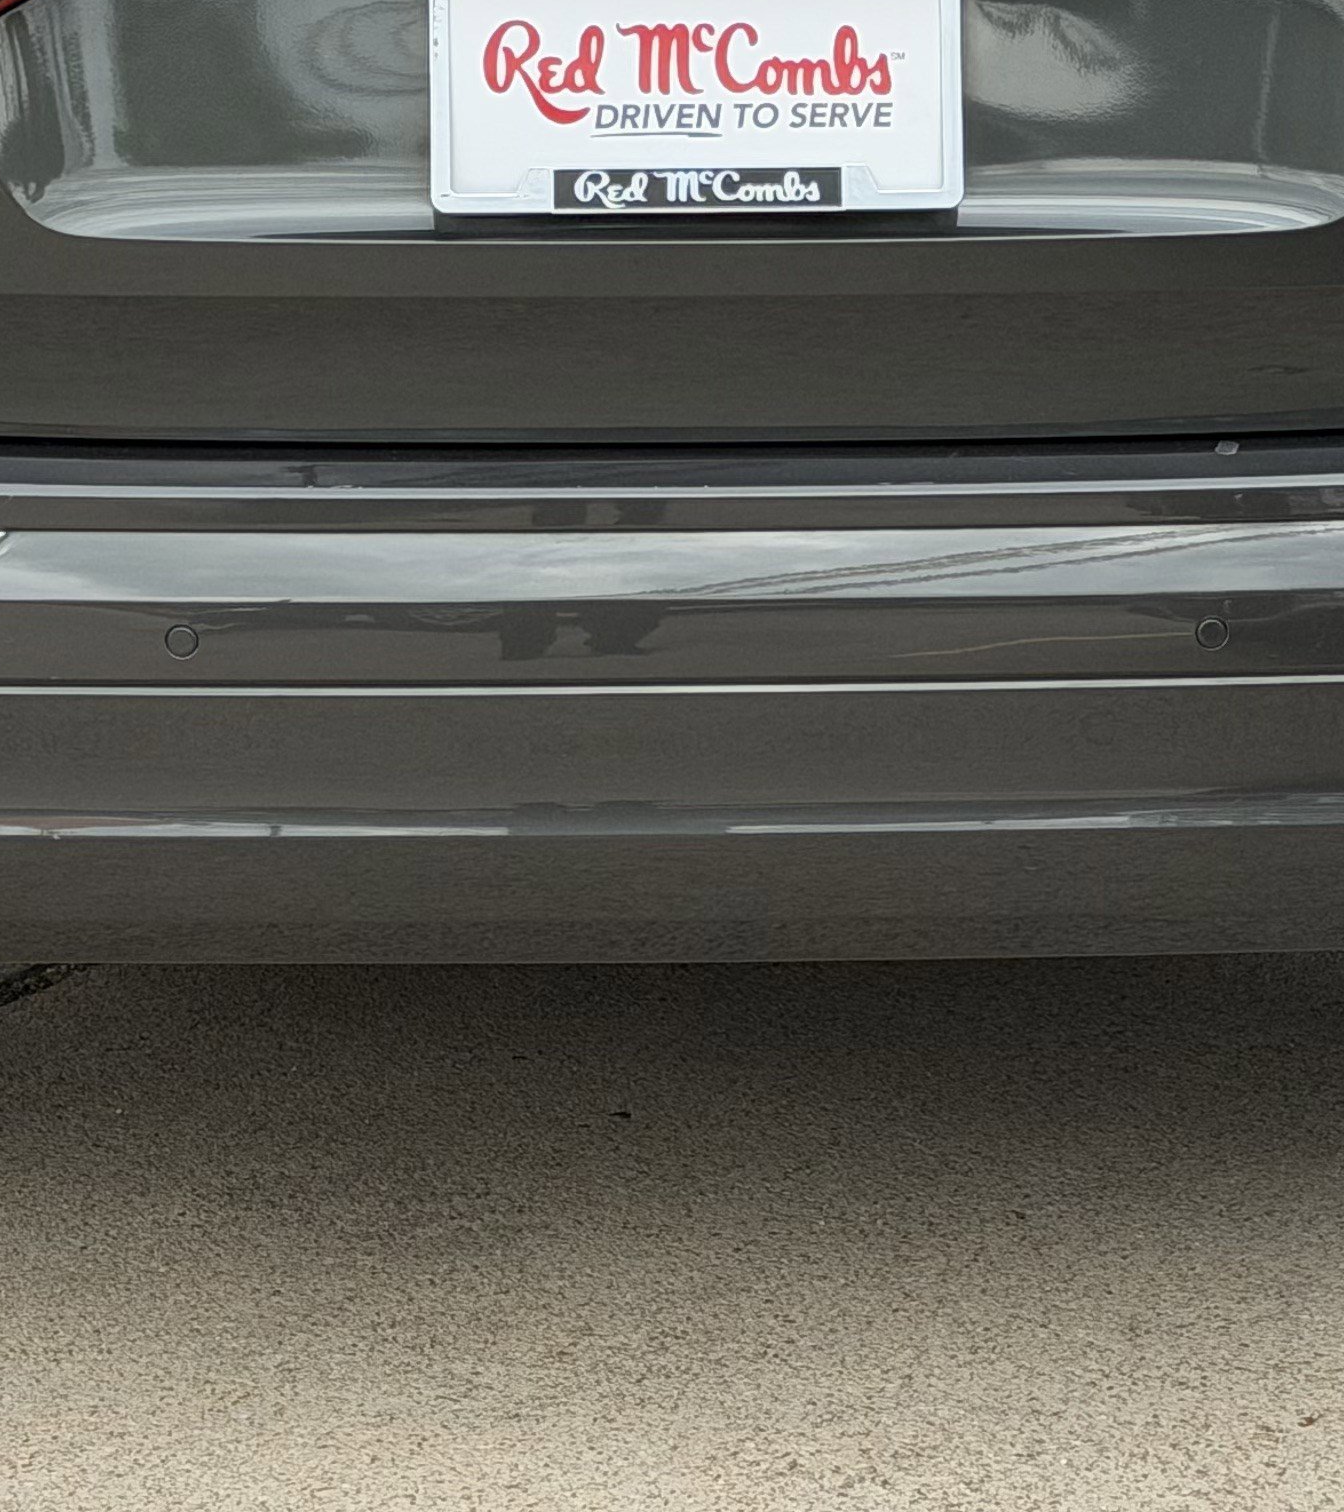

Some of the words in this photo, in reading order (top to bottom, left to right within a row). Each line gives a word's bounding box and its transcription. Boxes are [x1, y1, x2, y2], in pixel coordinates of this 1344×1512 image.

[483, 20, 605, 125] Red
[615, 22, 892, 96] McCombs
[594, 103, 723, 130] DRIVEN
[733, 102, 779, 129] TO
[788, 102, 894, 129] SERVE
[574, 171, 649, 208] Red
[651, 170, 821, 202] McCombs
